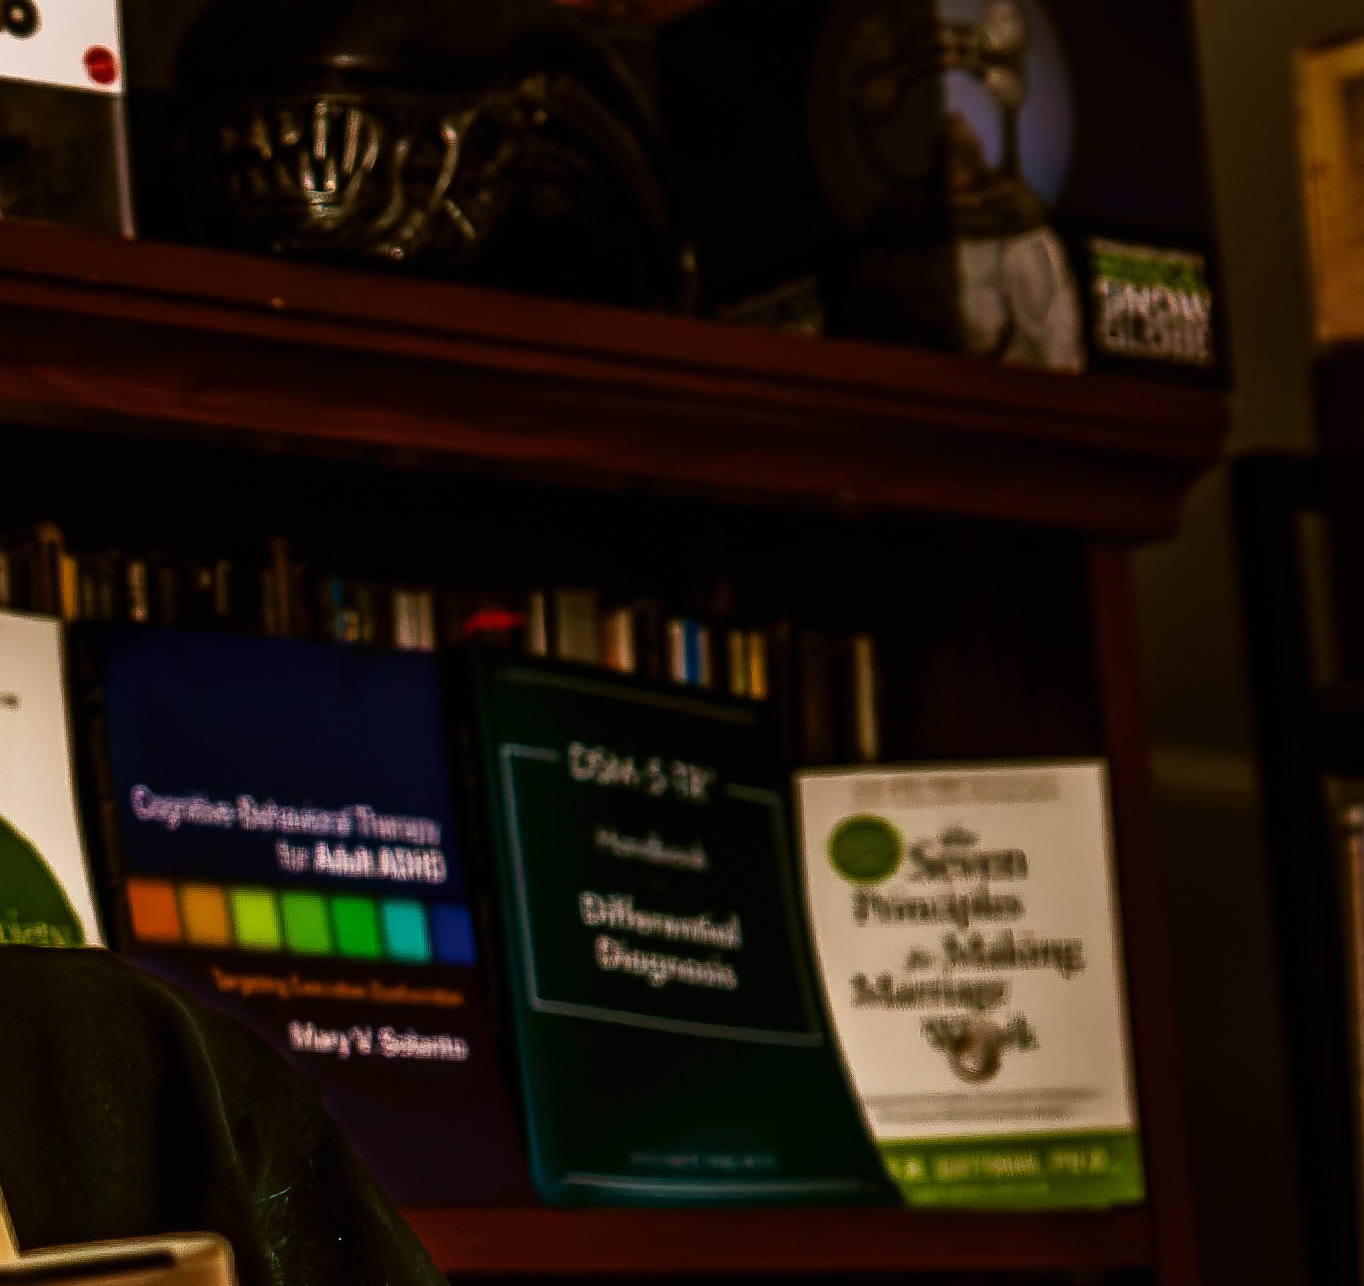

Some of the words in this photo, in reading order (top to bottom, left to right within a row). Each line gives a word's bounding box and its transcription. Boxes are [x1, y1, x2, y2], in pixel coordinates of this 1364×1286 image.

[129, 783, 235, 831] Cognitive
[236, 793, 353, 837] Behavioral
[354, 802, 444, 846] Therapy
[275, 837, 310, 874] for
[313, 839, 376, 879] Adult
[378, 845, 449, 886] ADHD
[910, 842, 1029, 883] Seven
[577, 889, 744, 953] Differential
[850, 887, 1024, 930] Principles
[941, 929, 1087, 981] Making
[849, 972, 1010, 1011] Marriage
[286, 1019, 351, 1061] Mary
